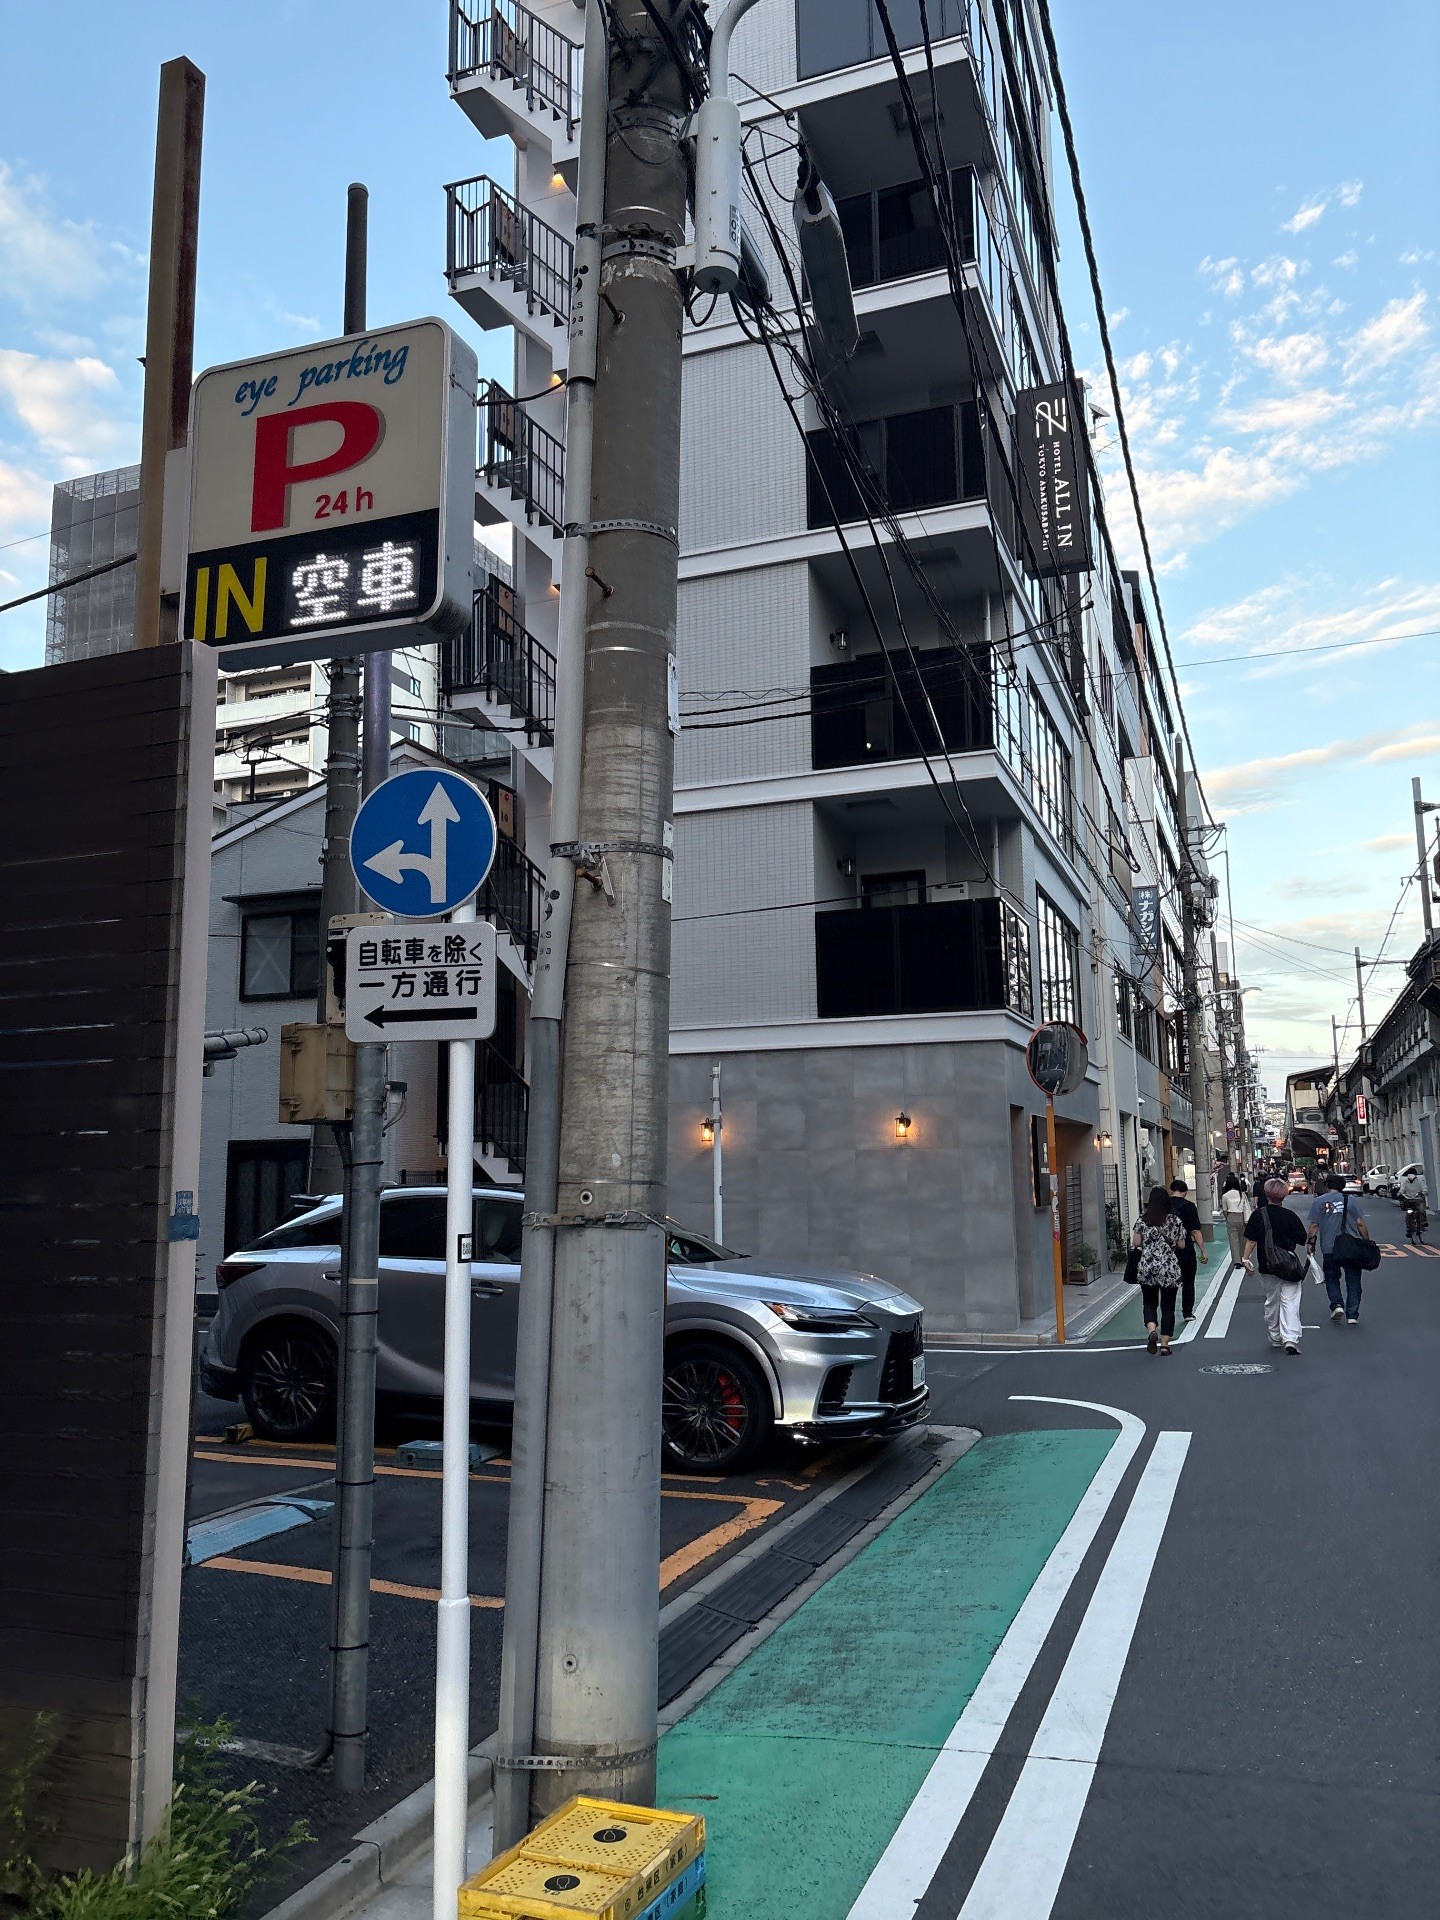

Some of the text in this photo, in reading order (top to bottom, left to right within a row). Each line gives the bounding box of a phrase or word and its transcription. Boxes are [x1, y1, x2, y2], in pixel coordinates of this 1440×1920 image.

[235, 340, 410, 416] eye parking
[250, 401, 385, 532] P
[1038, 444, 1047, 477] TOKYO
[1052, 440, 1073, 547] HOTEL ALL IN
[193, 556, 267, 641] IN
[289, 541, 416, 627] 空車
[359, 934, 483, 966] 自転車を除く
[359, 969, 482, 999] 一方通行
